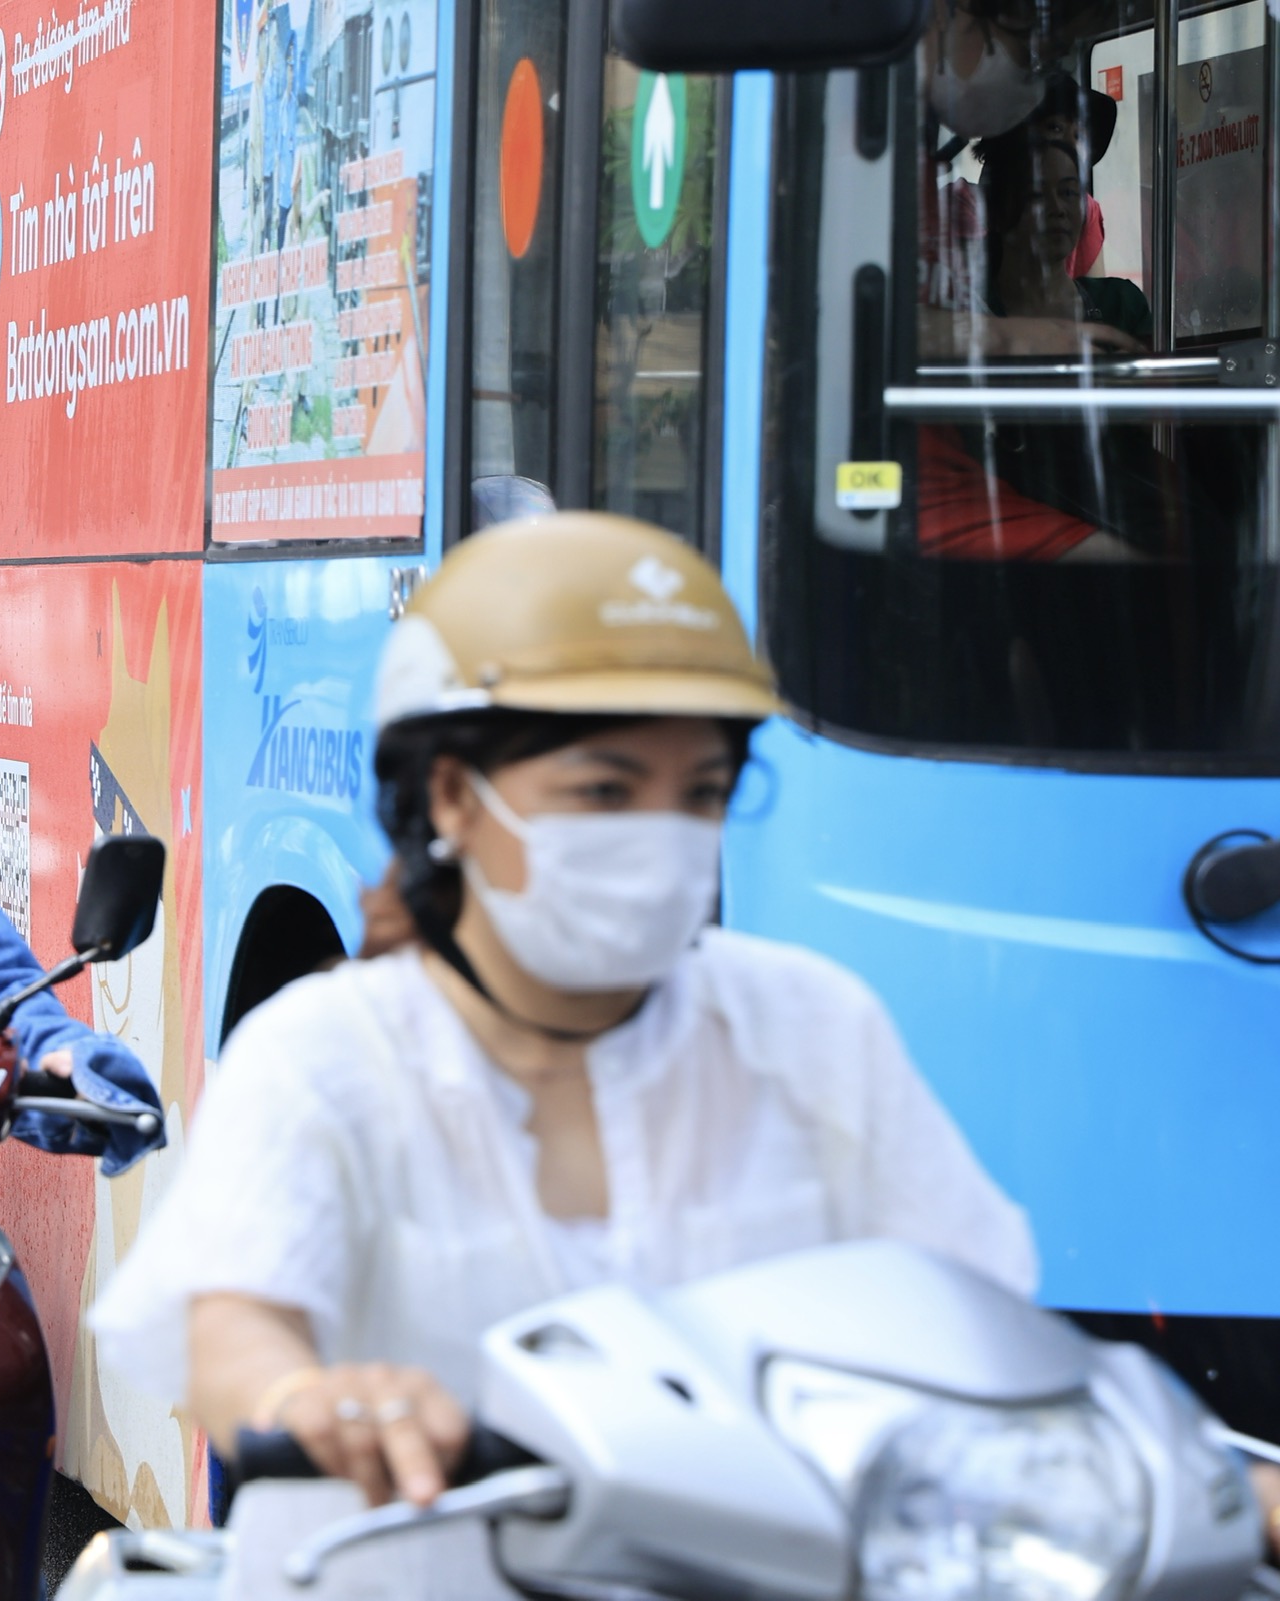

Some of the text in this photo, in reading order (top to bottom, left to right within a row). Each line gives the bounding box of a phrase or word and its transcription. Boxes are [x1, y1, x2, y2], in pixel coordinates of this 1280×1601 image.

[9, 131, 155, 276] Tìm nhà tốt trên
[6, 295, 190, 419] Batdongsan.com.vn
[850, 470, 885, 489] OK
